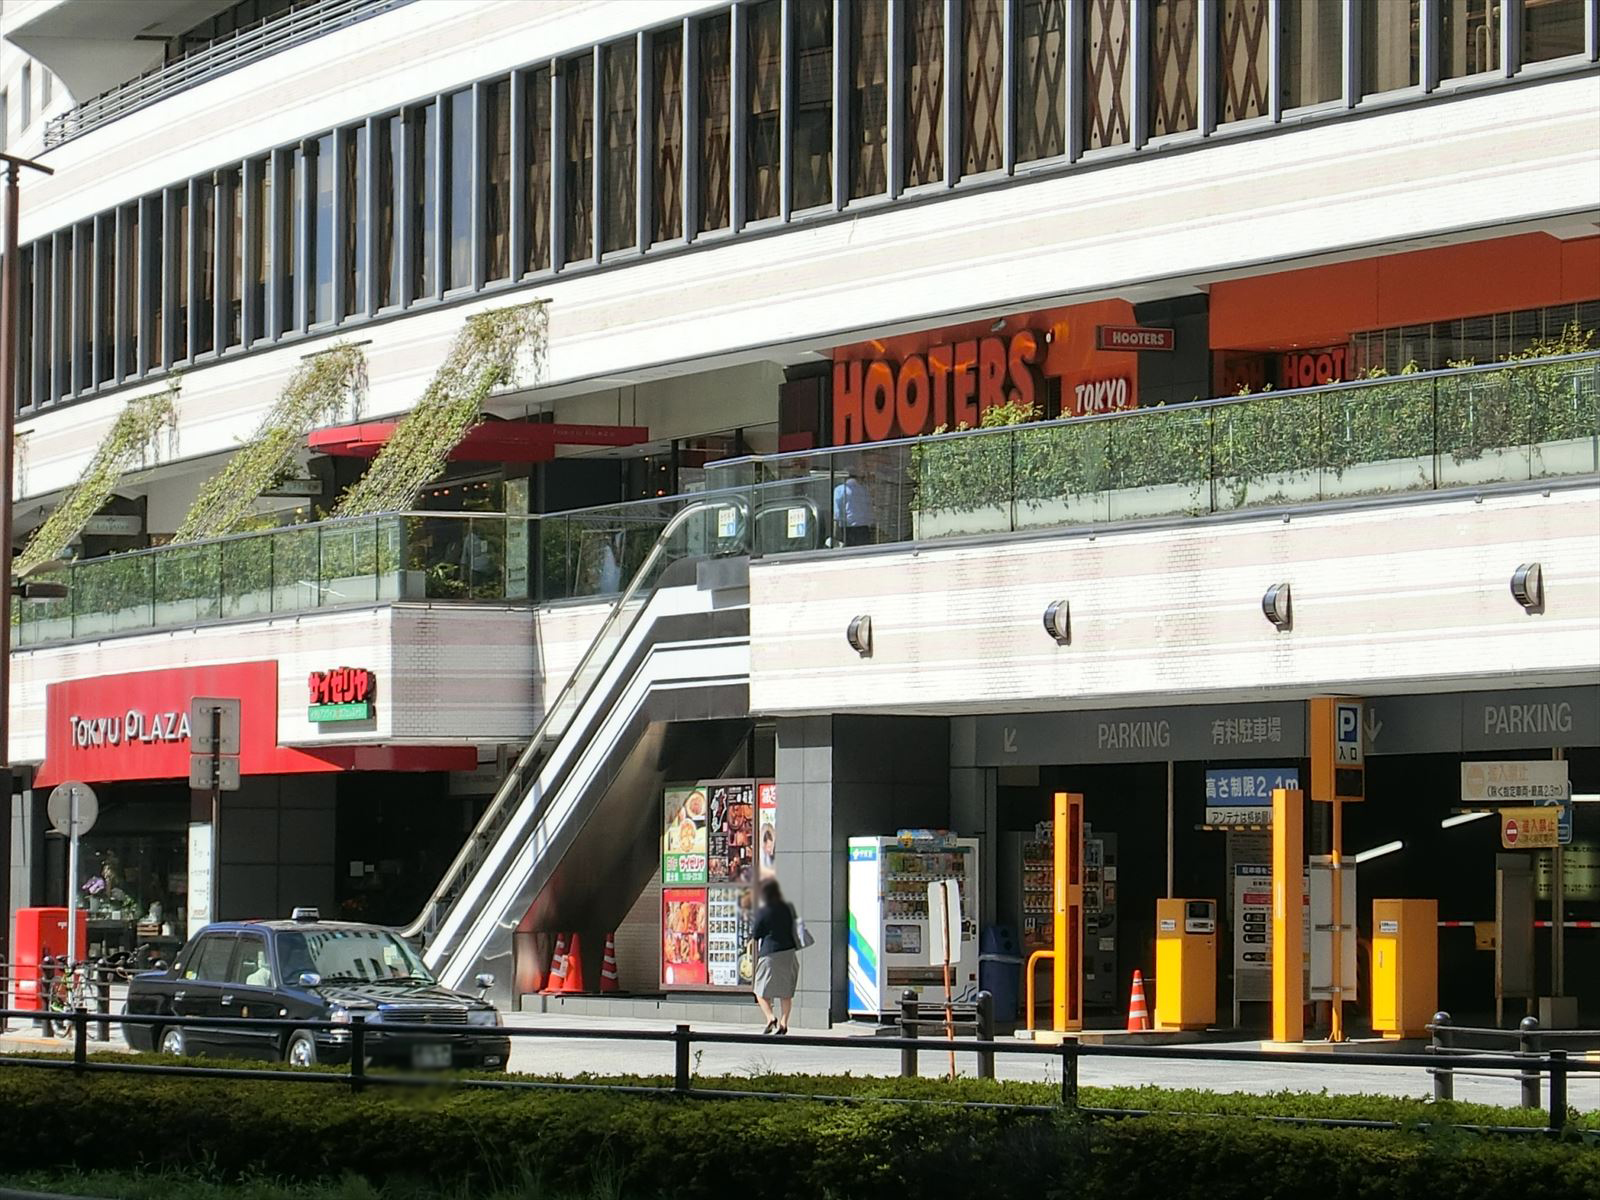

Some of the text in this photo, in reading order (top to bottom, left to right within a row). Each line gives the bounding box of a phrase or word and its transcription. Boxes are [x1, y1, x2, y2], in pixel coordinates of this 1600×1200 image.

[1112, 331, 1165, 345] HOOTERS
[832, 327, 1037, 447] HOOTERS
[1075, 378, 1127, 413] TOKYO
[307, 666, 370, 703] サイゼリヤ
[69, 710, 191, 747] TOKYU PLAZA
[1097, 720, 1171, 749] PARKING
[1211, 716, 1282, 745] 有料駐車場
[1339, 709, 1356, 740] P
[1483, 702, 1573, 735] PARKING
[1338, 745, 1358, 761] 入口
